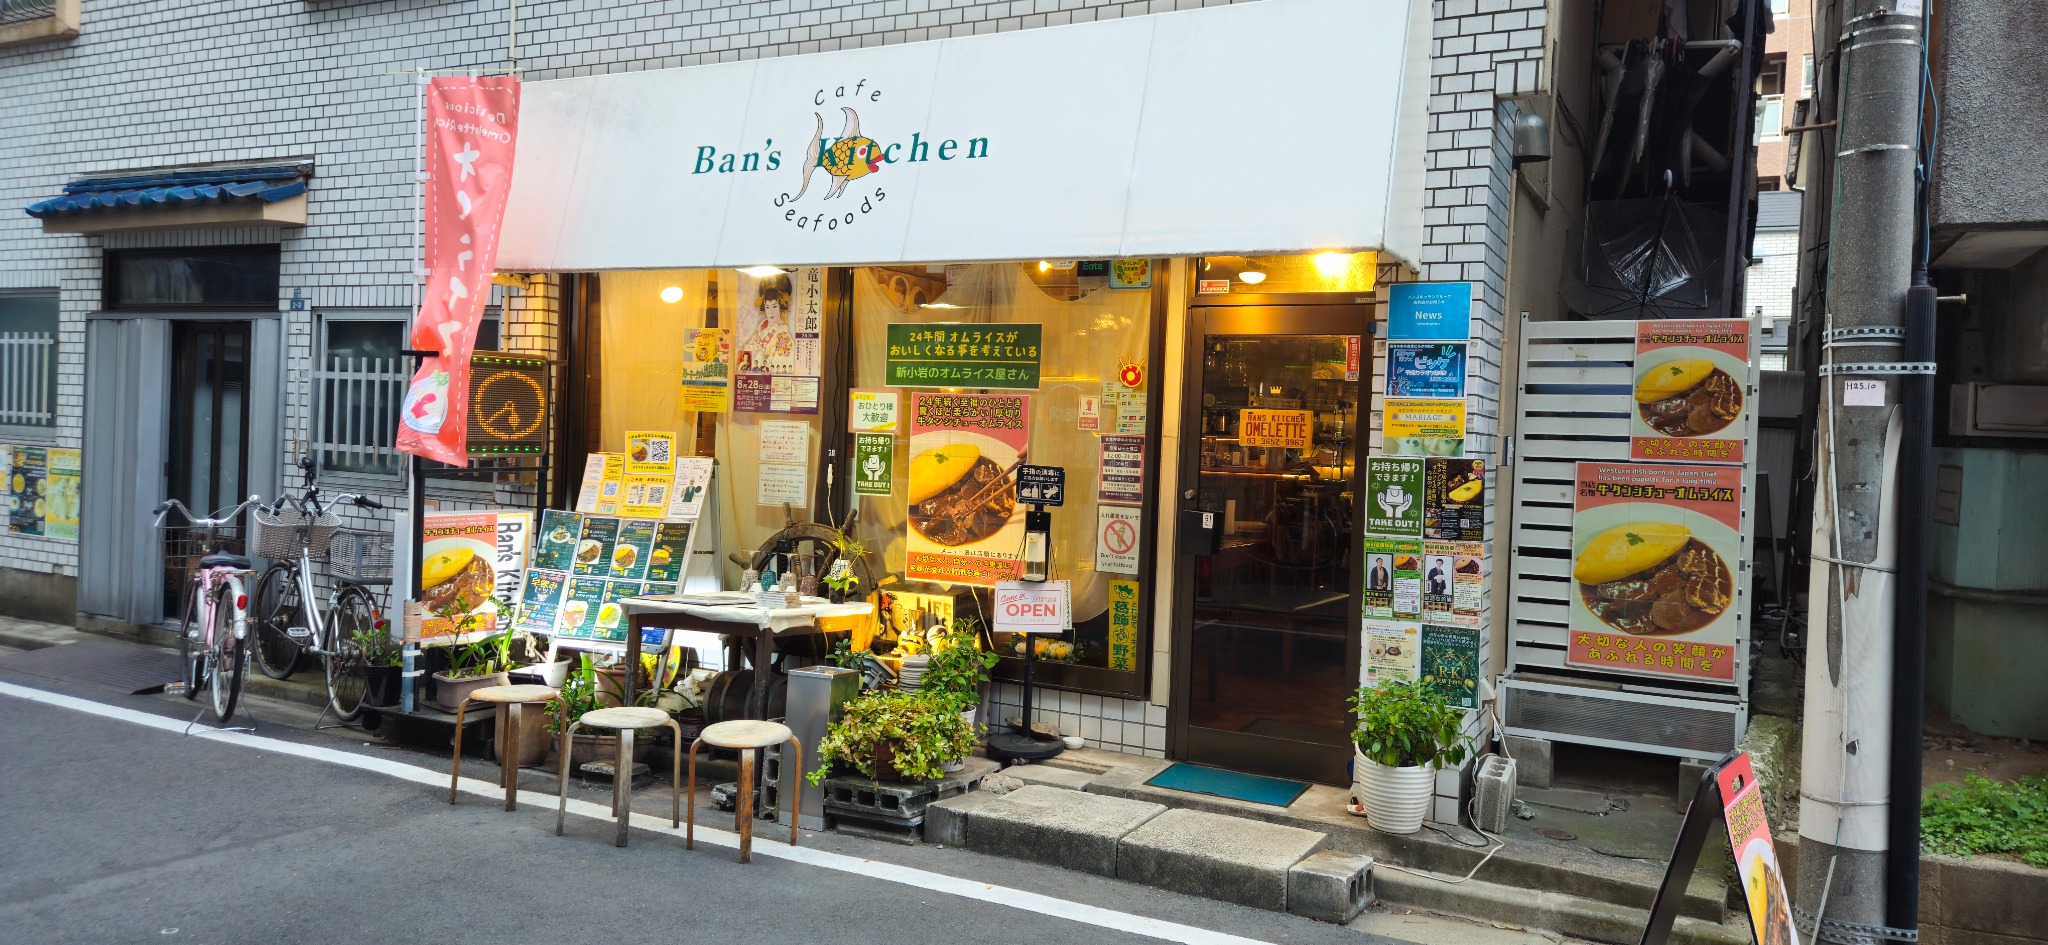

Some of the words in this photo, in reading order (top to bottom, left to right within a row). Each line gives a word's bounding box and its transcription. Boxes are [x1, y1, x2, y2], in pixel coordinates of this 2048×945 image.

[814, 78, 881, 106] Cafe
[691, 138, 781, 175] Ban's
[815, 132, 989, 168] Kitchen
[774, 187, 886, 232] Seafoods
[1083, 261, 1103, 270] Eats
[804, 268, 819, 331] 竜小太郎
[1415, 310, 1442, 320] News
[910, 330, 945, 342] 24年間
[949, 330, 1019, 344] オムライスが
[1650, 333, 1744, 344] 牛タンシチューオムライス
[890, 344, 1037, 358] おいしくなる事を考えている
[896, 366, 1029, 380] 新小岩のオムライス屋さん
[858, 402, 894, 410] おひとり様
[919, 396, 1022, 408] 24年続く至福のひととき
[862, 412, 888, 422] 大歓迎
[916, 417, 1024, 429] 牛タンシチューオムライス
[1246, 422, 1306, 438] OMELETTE
[858, 436, 890, 444] お持ち帰り
[1637, 440, 1738, 450] 大切な人の笑顔が
[1644, 448, 1729, 458] あふれる時間を
[1372, 462, 1420, 472] お持ち帰り
[1580, 480, 1596, 488] 当店
[1596, 483, 1734, 502] 牛タンシチューオムライス
[1369, 518, 1392, 527] TAKE
[497, 522, 522, 563] Ban's
[1006, 604, 1056, 616] OPEN
[1577, 634, 1727, 660] 大切な人の笑顔が
[1588, 647, 1713, 672] あふれる時間を
